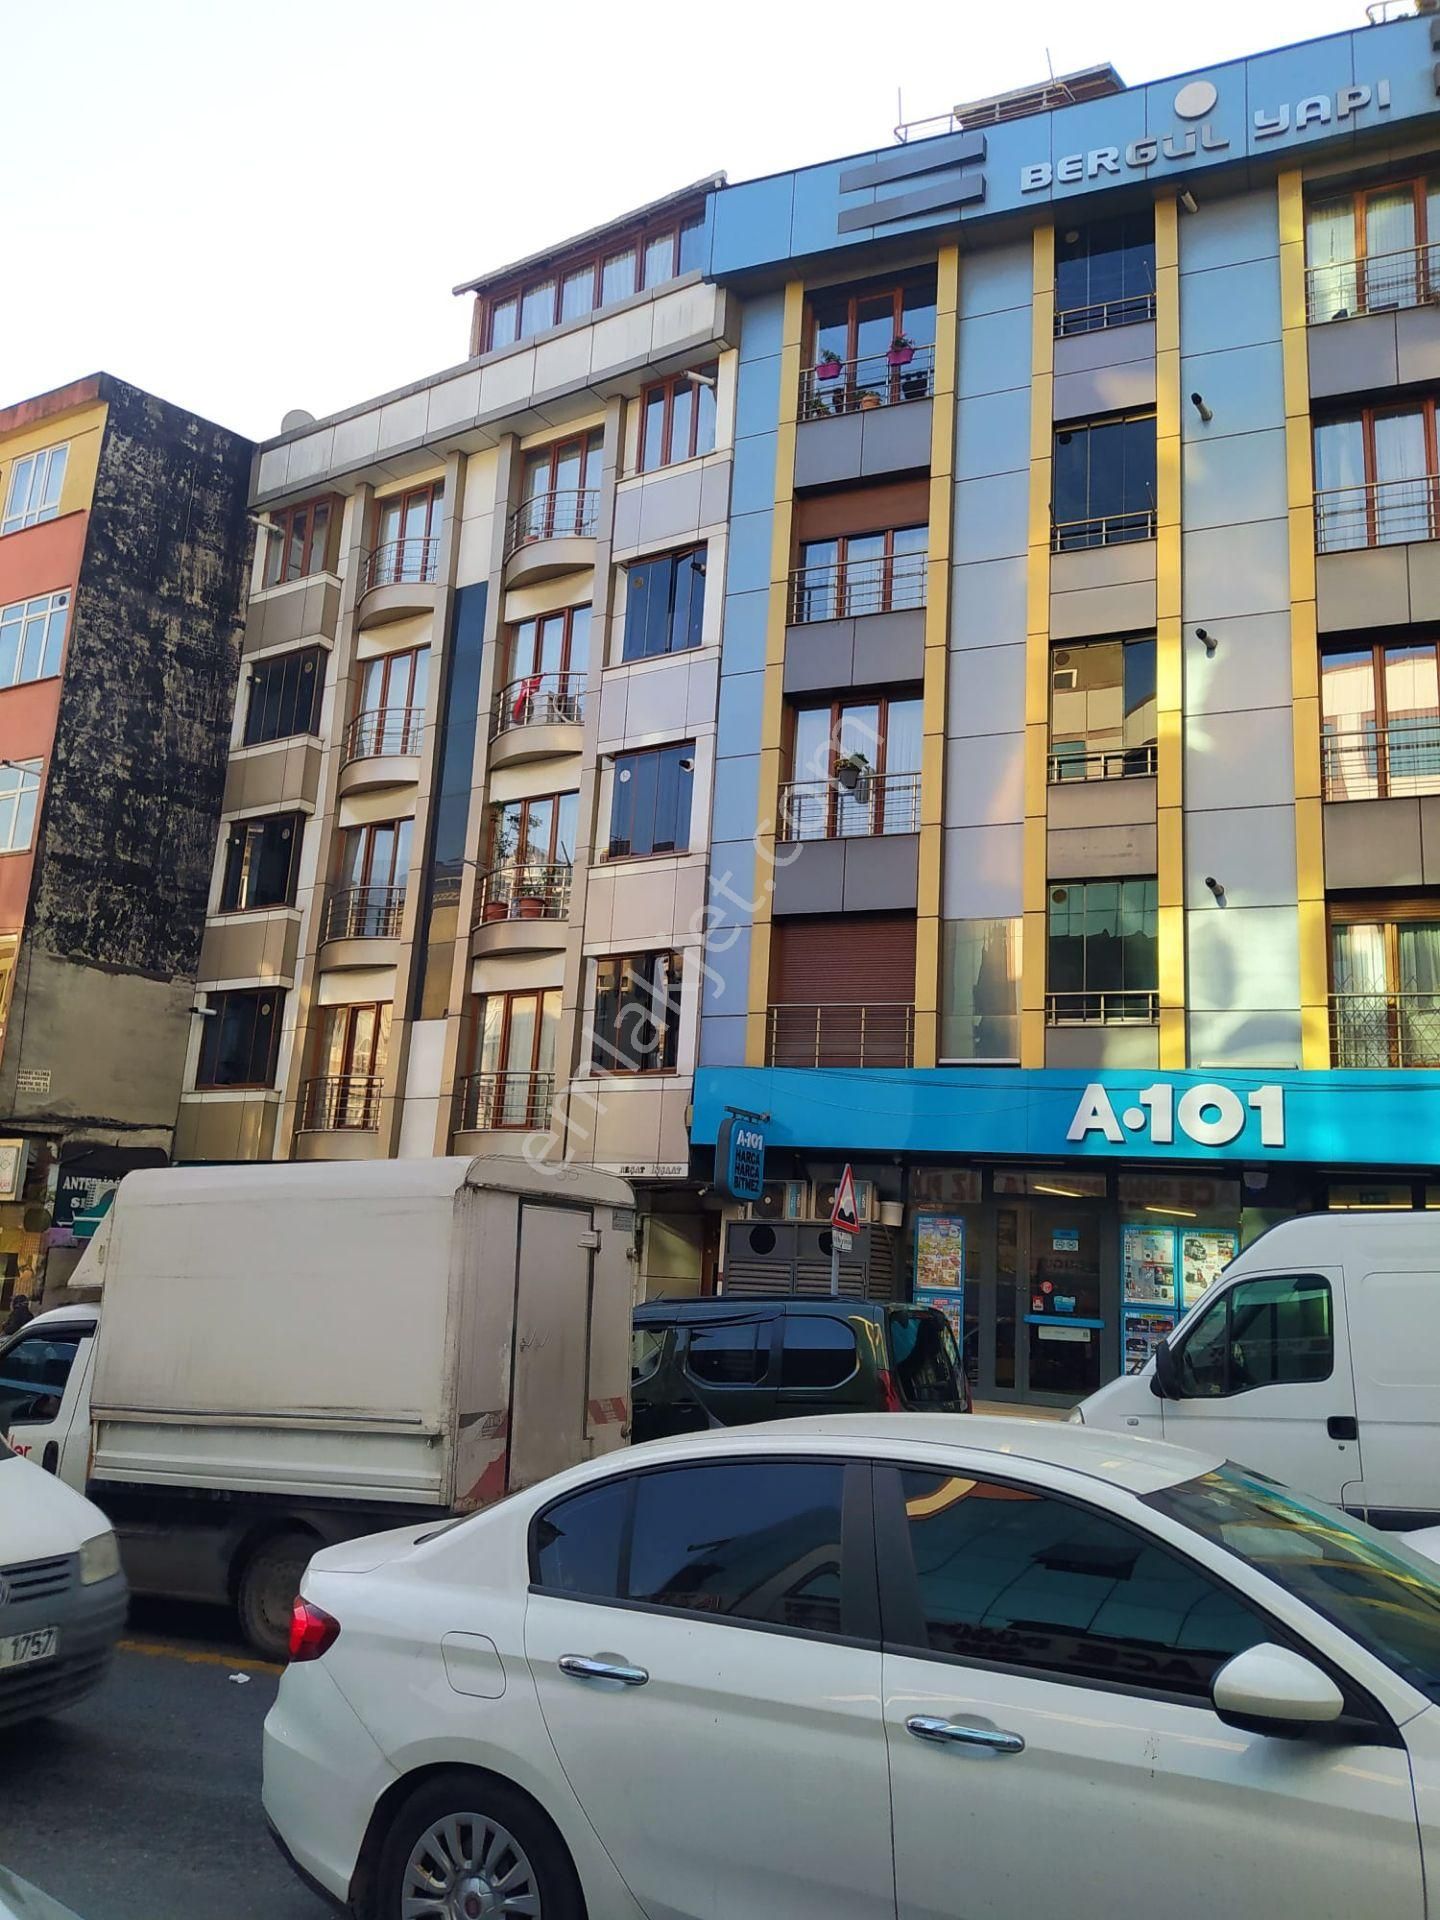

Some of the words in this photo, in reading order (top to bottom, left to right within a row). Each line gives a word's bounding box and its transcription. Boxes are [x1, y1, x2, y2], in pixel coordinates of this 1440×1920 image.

[1020, 124, 1231, 193] BERGÜL
[1254, 79, 1391, 141] YAPI
[736, 1149, 761, 1166] HARCA
[735, 1162, 760, 1179] HARCA
[11, 1629, 54, 1661] 1757
